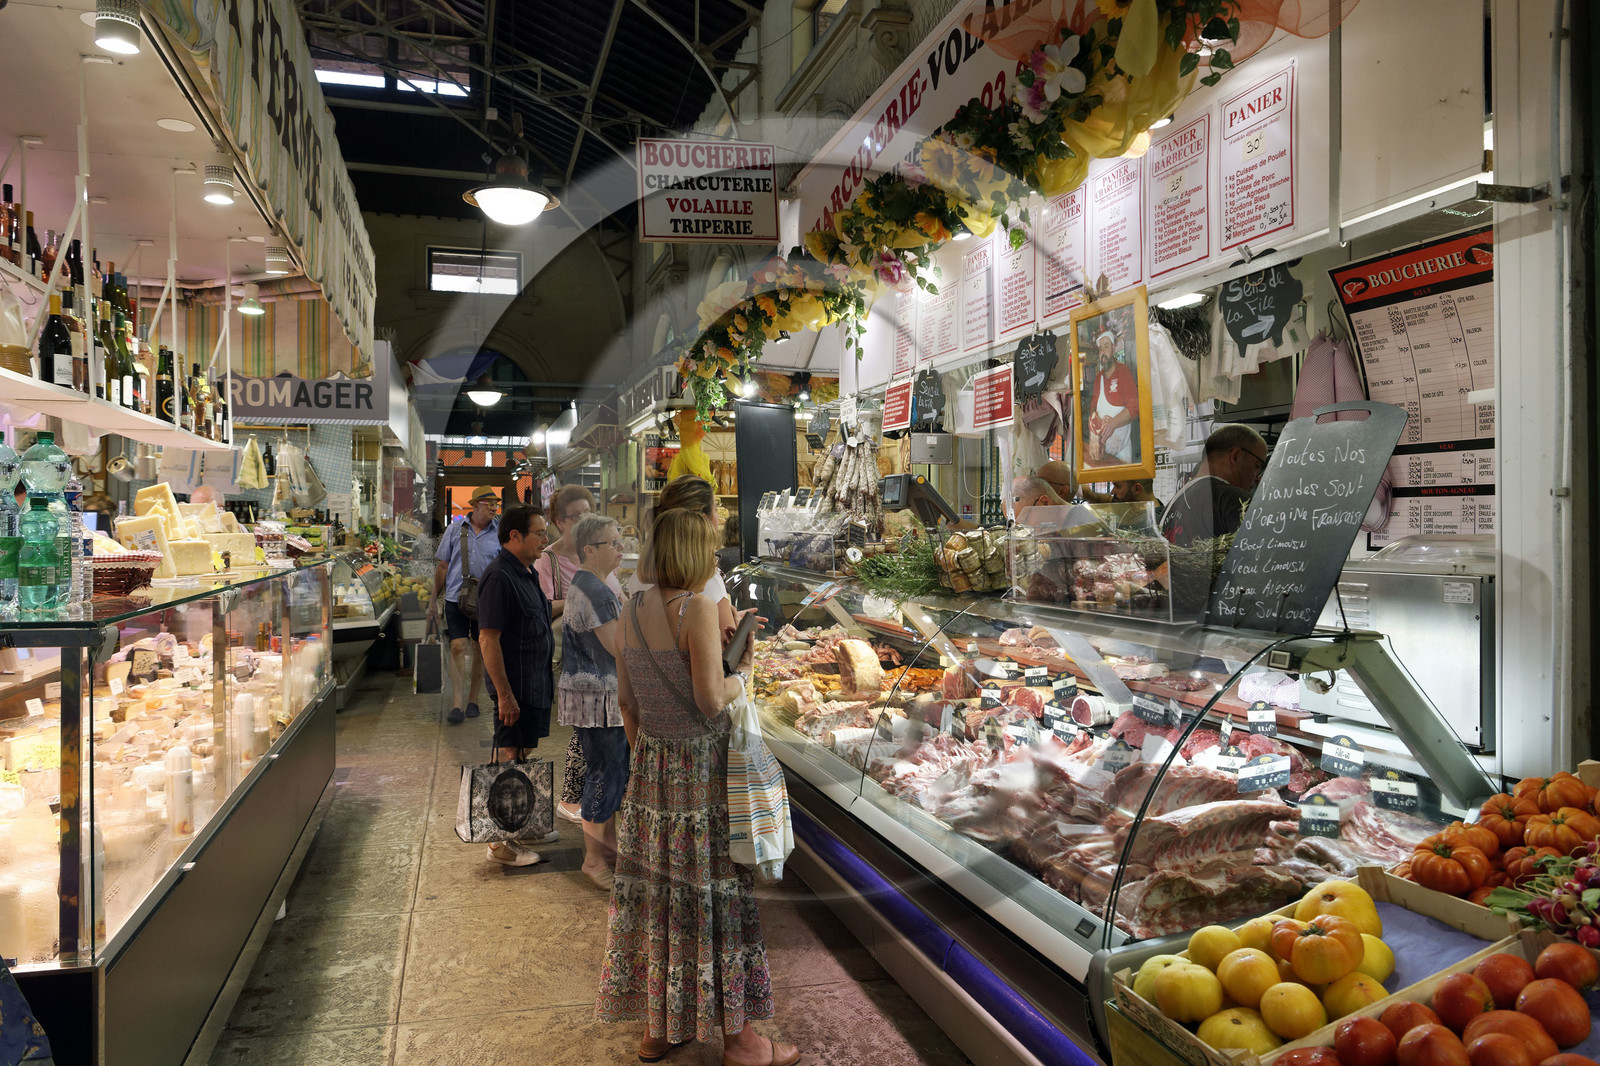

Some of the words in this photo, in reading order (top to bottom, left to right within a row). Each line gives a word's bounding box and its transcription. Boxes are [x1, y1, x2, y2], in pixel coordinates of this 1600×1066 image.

[1229, 87, 1281, 127] PANIER
[1161, 128, 1197, 157] PANIER
[644, 143, 772, 171] BOUCHERIE
[1154, 139, 1203, 173] BARBECUE
[1235, 163, 1257, 177] Cuisses
[1267, 149, 1286, 162] Poulet
[644, 174, 773, 193] CHARCUTERIE
[1095, 170, 1137, 199] CHARCUTERIE
[1102, 164, 1129, 187] PANIER
[1236, 174, 1253, 185] Daube
[1236, 183, 1251, 194] Côtes
[1261, 173, 1274, 182] Porc
[1246, 185, 1267, 198] Agneau
[666, 198, 754, 215] VOLAILLE
[1050, 194, 1076, 214] PANIER
[1166, 198, 1190, 212] Chipolatas
[1229, 200, 1252, 214] Cordons
[1253, 192, 1269, 203] Bleus
[1236, 211, 1245, 219] Pot
[1254, 203, 1265, 212] Feu
[1163, 217, 1181, 229] Cuisses
[1189, 207, 1205, 218] Poulet
[1166, 208, 1185, 220] Merguez
[1184, 219, 1195, 228] Porc
[1232, 214, 1261, 229] Chipolatas
[670, 219, 753, 235] TRIPERIE
[1188, 224, 1202, 234] Dinde
[1232, 225, 1255, 237] Merguez
[1188, 234, 1199, 242] Porc
[967, 249, 988, 265] PANIER
[1158, 251, 1177, 262] Cordons
[1178, 245, 1191, 254] Bleus
[1367, 251, 1467, 289] BOUCHERIE
[1226, 277, 1267, 302] Sens
[1268, 267, 1285, 288] de
[1226, 309, 1243, 324] La
[1244, 295, 1276, 315] File
[216, 378, 374, 410] ROMAGER
[1278, 438, 1325, 468] Toutes
[1334, 439, 1366, 464] Nos
[1231, 558, 1258, 574] Veau
